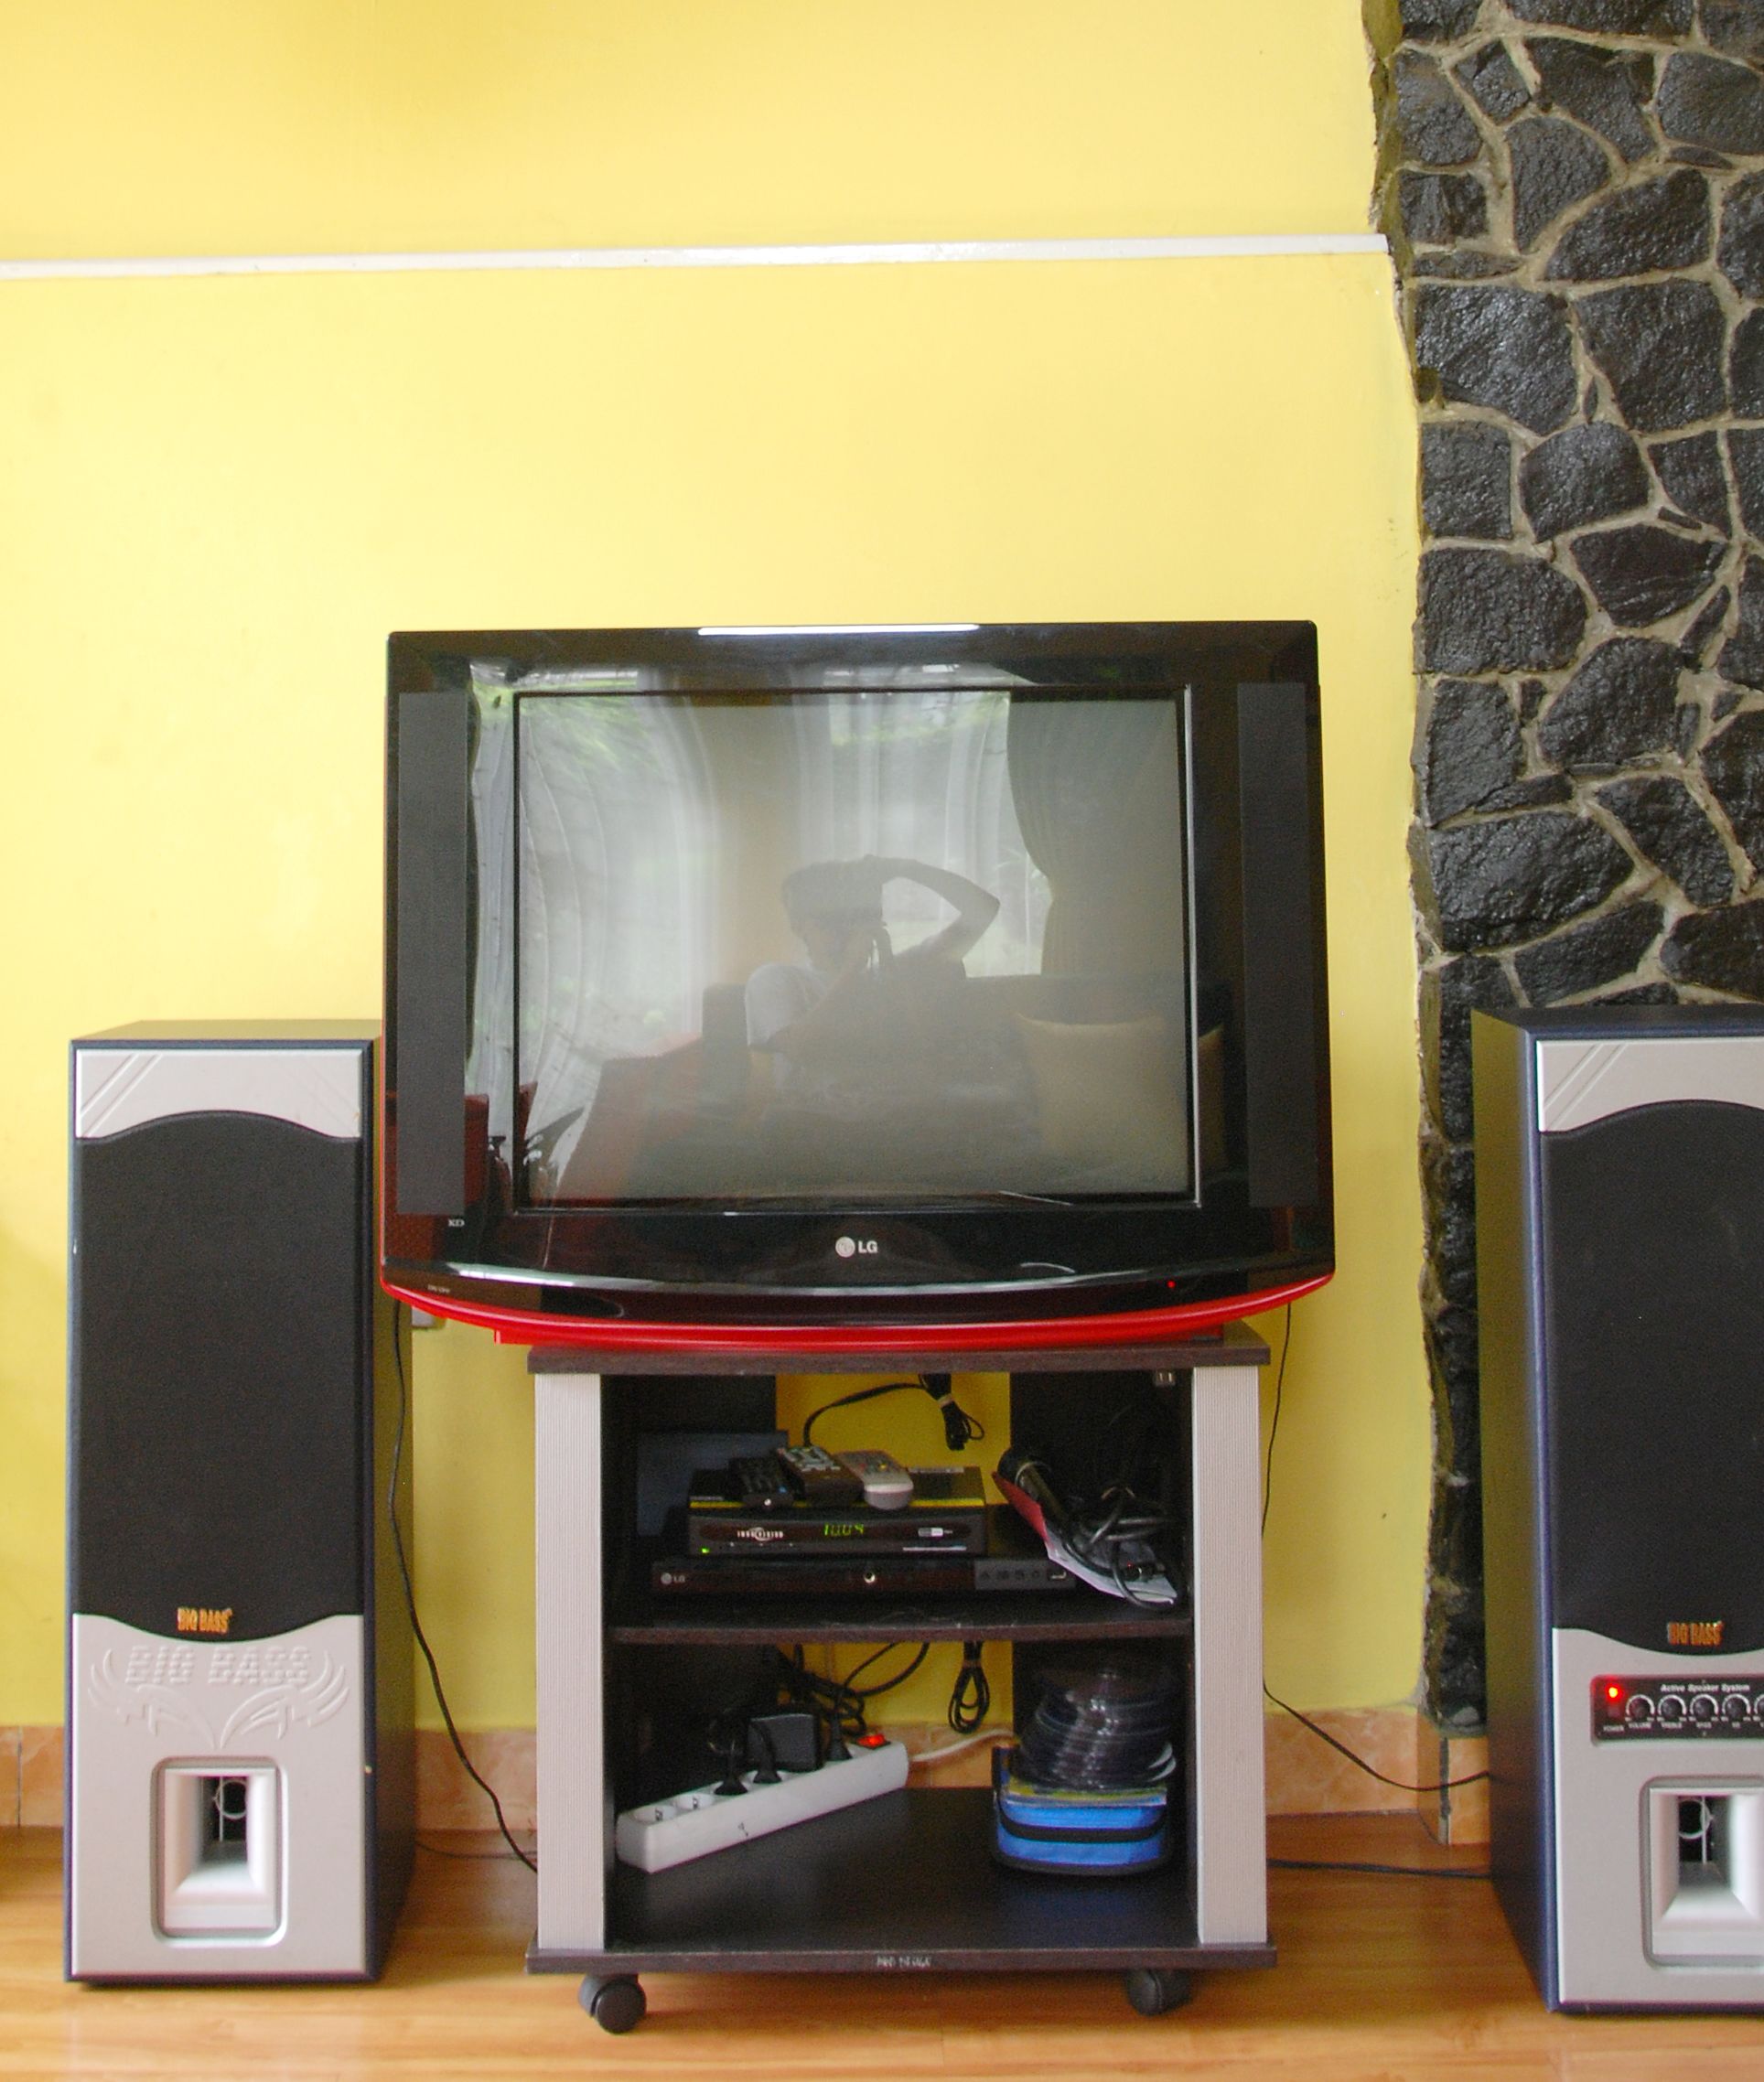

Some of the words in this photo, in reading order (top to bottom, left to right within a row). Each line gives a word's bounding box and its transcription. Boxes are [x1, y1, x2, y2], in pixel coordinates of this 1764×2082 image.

[857, 1240, 878, 1253] LG
[177, 1607, 198, 1631] BIG
[199, 1608, 230, 1634] BASS
[1667, 1622, 1689, 1645] BIG
[1690, 1622, 1723, 1646] BASS
[124, 1646, 195, 1684] BIG
[1660, 1684, 1686, 1692] Active
[1687, 1684, 1720, 1693] Speaker
[1721, 1684, 1750, 1693] System
